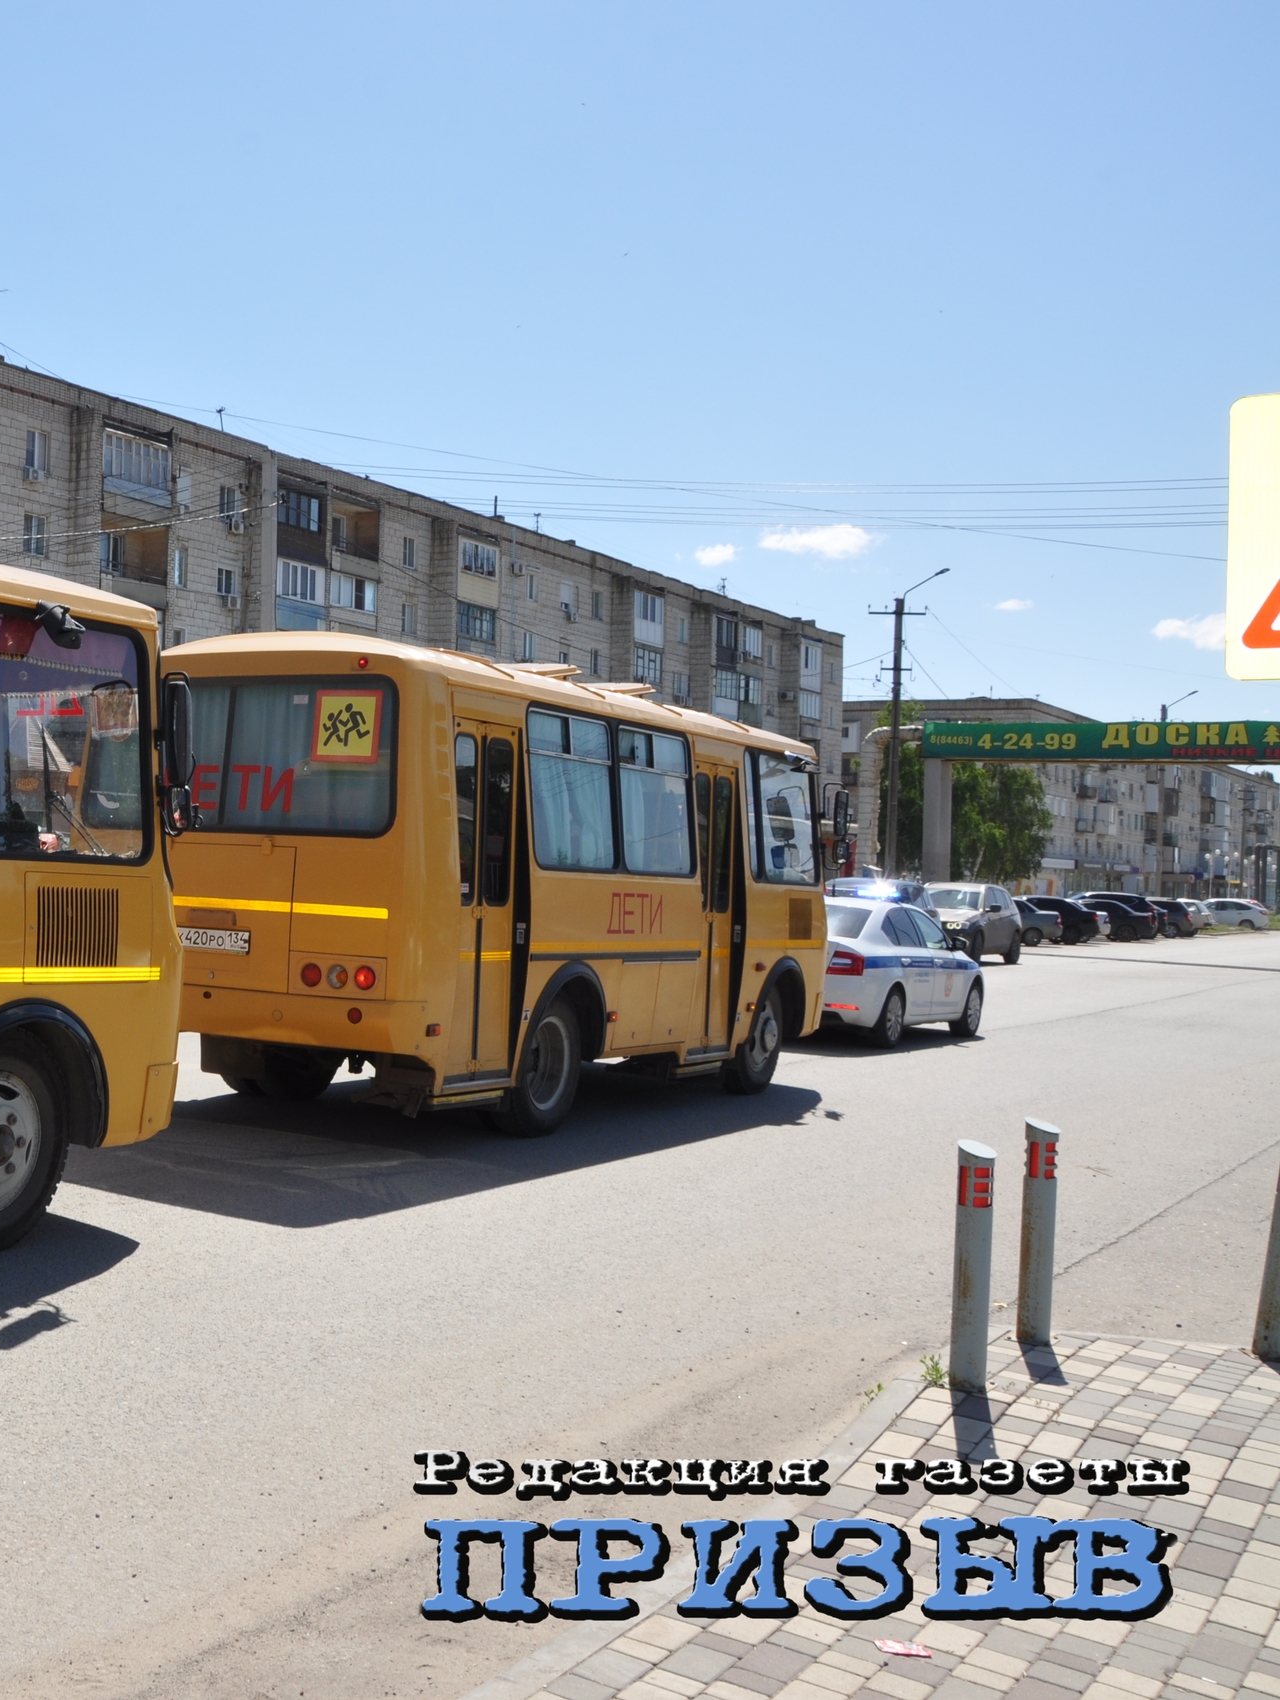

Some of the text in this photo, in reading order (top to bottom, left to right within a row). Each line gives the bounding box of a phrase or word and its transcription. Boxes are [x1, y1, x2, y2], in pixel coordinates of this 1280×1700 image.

[930, 732, 1077, 750] 8(84463) 4-24-99
[1101, 722, 1249, 749] ДОСКА
[1172, 747, 1257, 757] НИЗКИЕ
[163, 764, 295, 813] ЕТИ
[607, 892, 663, 934] ДЕТИ
